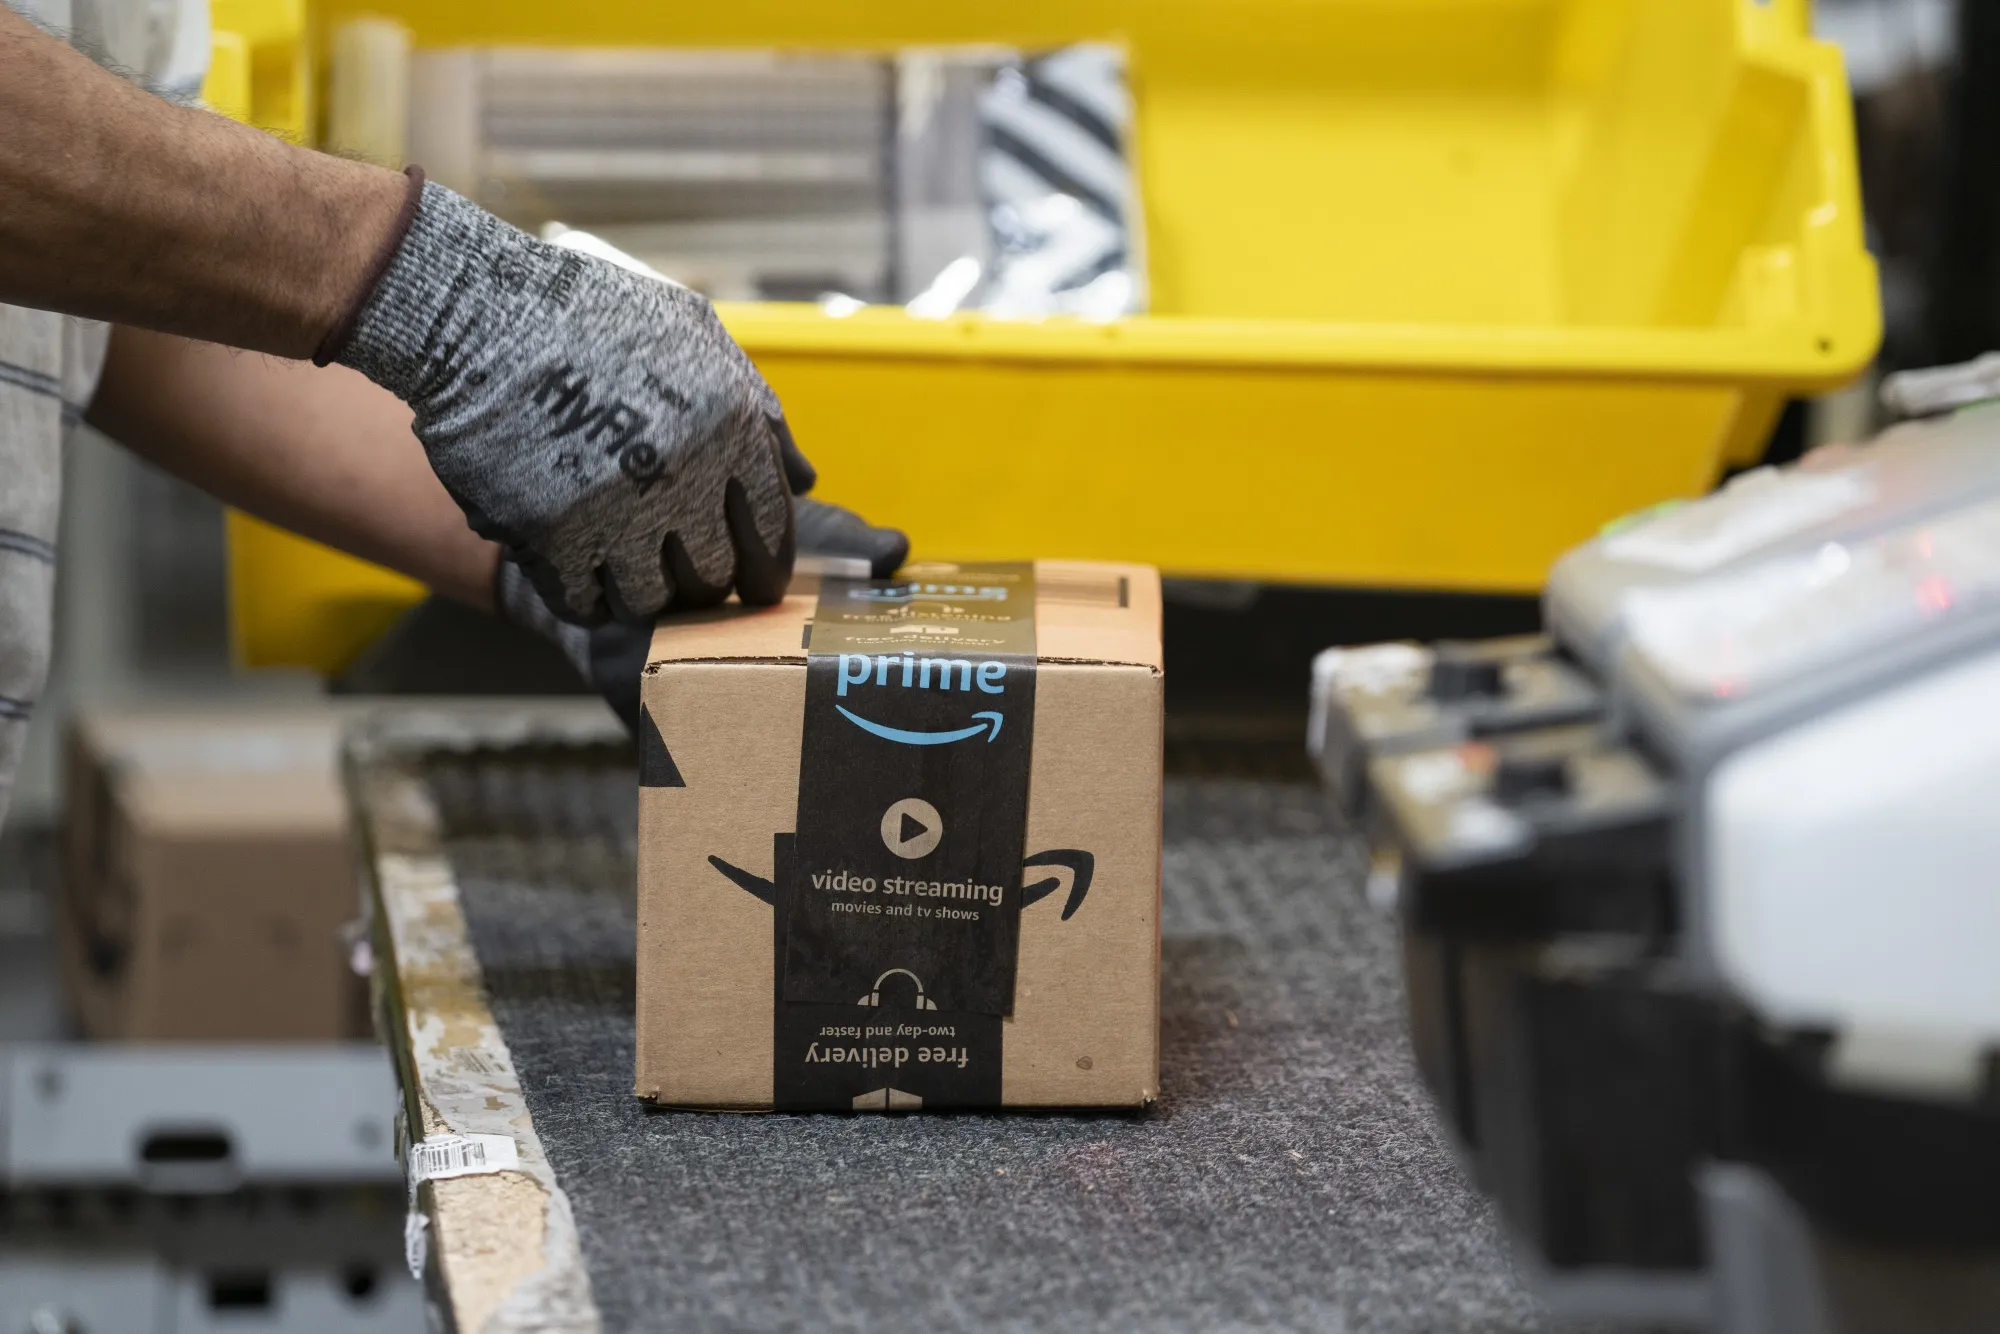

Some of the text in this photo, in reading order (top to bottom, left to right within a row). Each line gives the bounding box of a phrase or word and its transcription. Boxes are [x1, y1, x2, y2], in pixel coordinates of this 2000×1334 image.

[533, 364, 673, 496] HyFlex
[904, 634, 1006, 645] delivery
[837, 651, 1007, 696] prime
[811, 868, 1004, 906] video streaming
[831, 900, 980, 921] movies and tv shows
[819, 1023, 956, 1040] two-day and faster
[804, 1042, 969, 1069] free delivery
